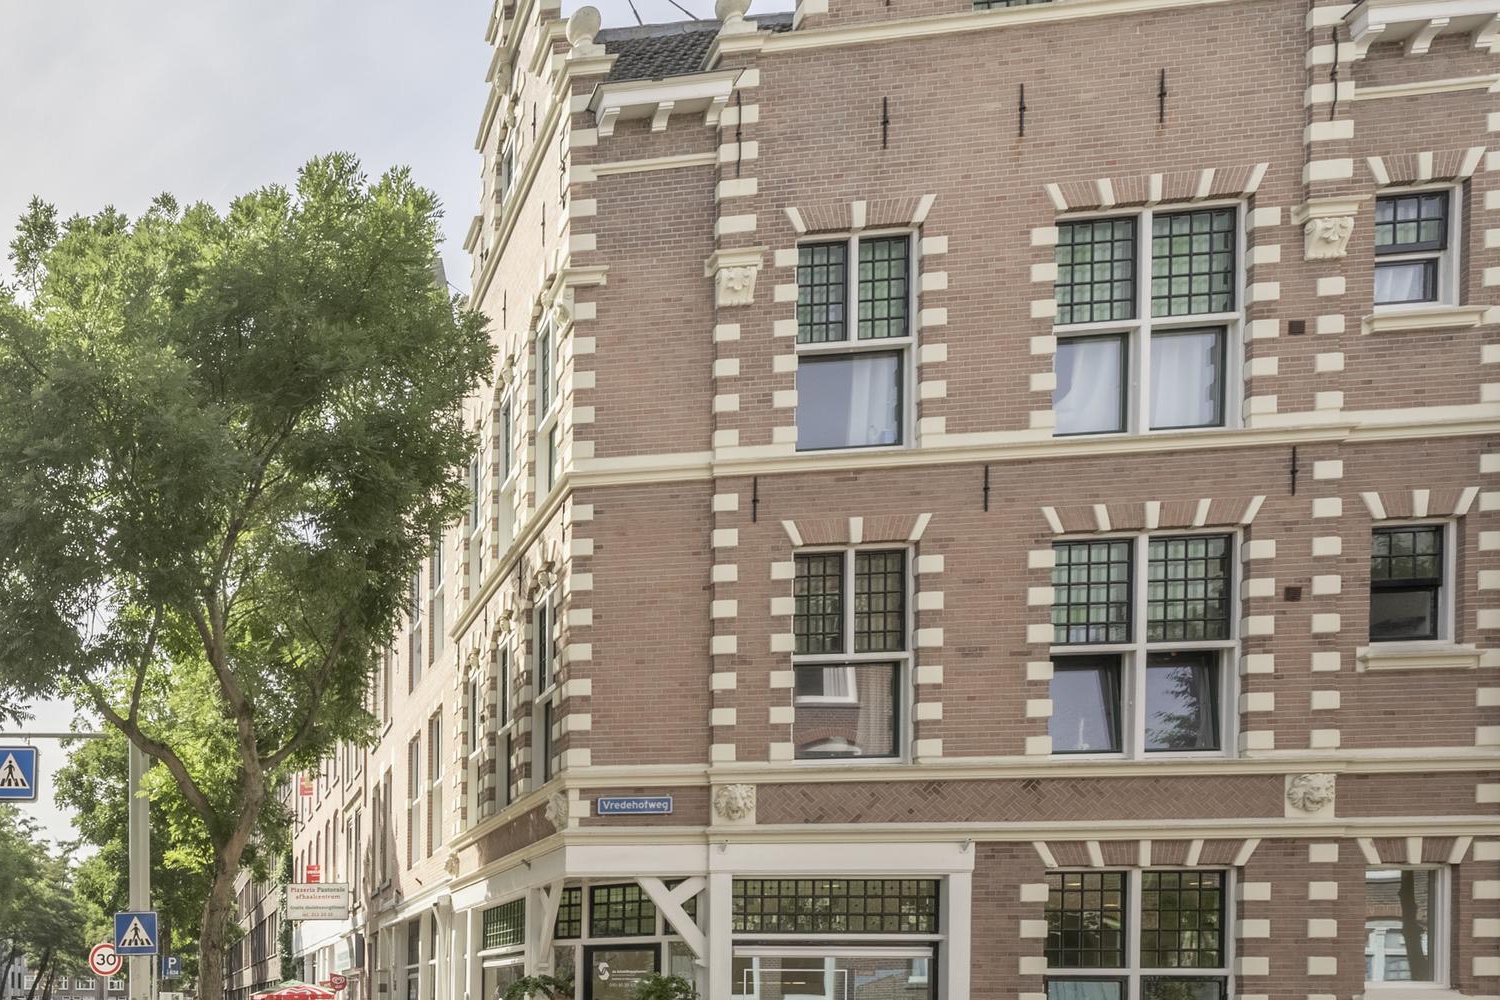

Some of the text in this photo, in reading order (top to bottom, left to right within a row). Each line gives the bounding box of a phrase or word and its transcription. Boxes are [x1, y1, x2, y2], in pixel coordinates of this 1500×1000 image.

[603, 801, 669, 811] Vredehofweg
[96, 953, 116, 966] 30
[168, 957, 177, 969] P
